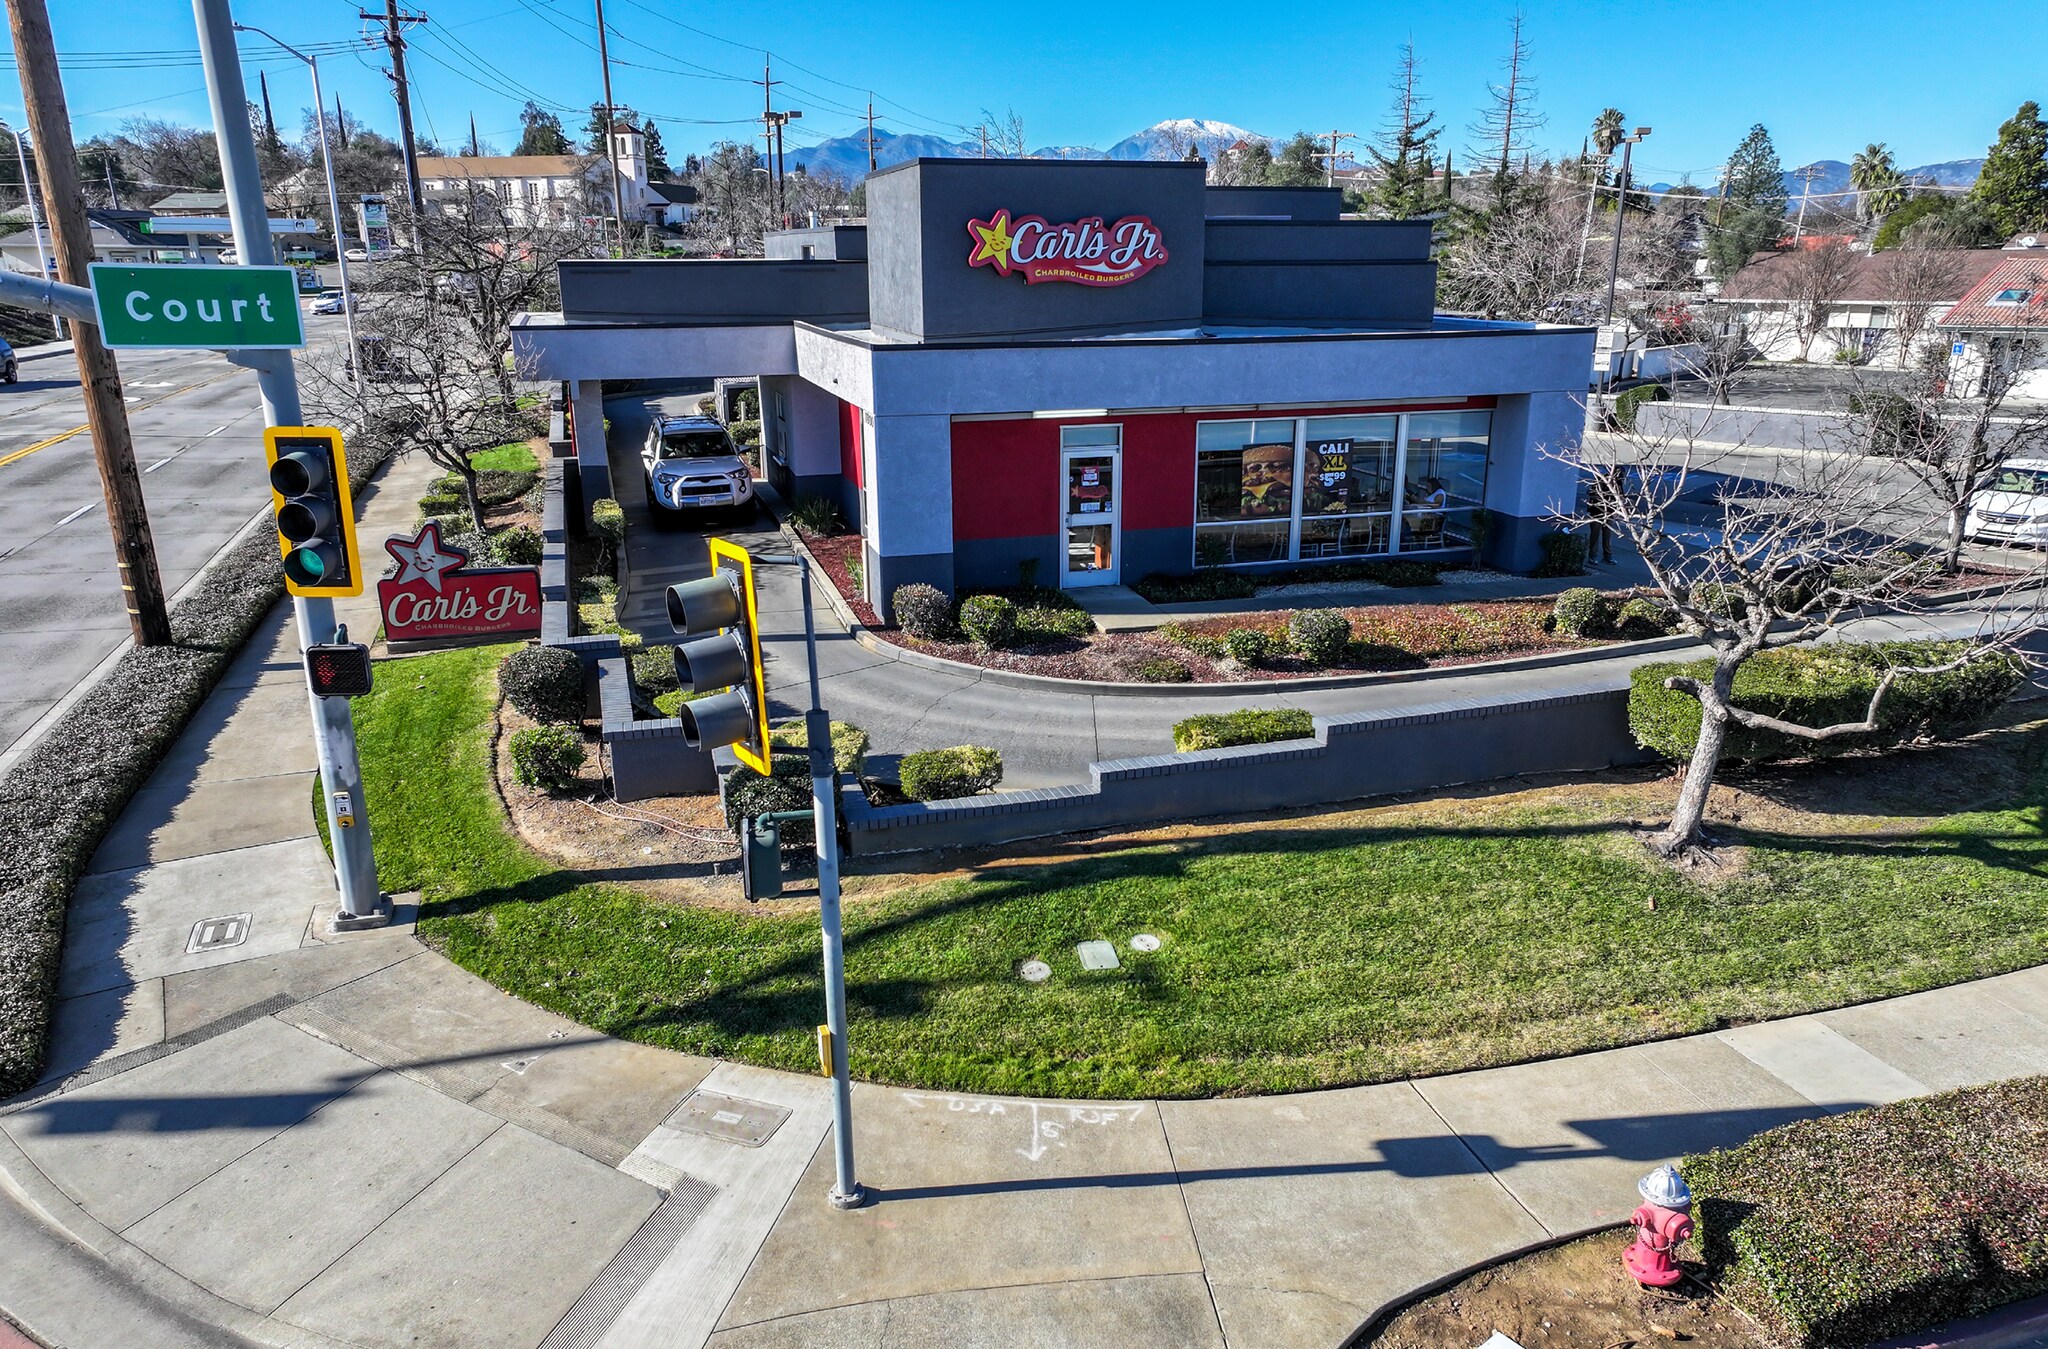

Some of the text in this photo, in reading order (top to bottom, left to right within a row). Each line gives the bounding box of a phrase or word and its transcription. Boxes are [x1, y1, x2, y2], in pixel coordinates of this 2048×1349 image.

[1011, 221, 1109, 264] Carl's
[1035, 268, 1135, 282] CHARBROILED BURGERS
[125, 290, 275, 322] Court
[1318, 442, 1350, 455] CALI
[1322, 454, 1348, 472] XL
[387, 586, 483, 627] Carl's
[414, 621, 512, 632] CHARBROILED BURGERS
